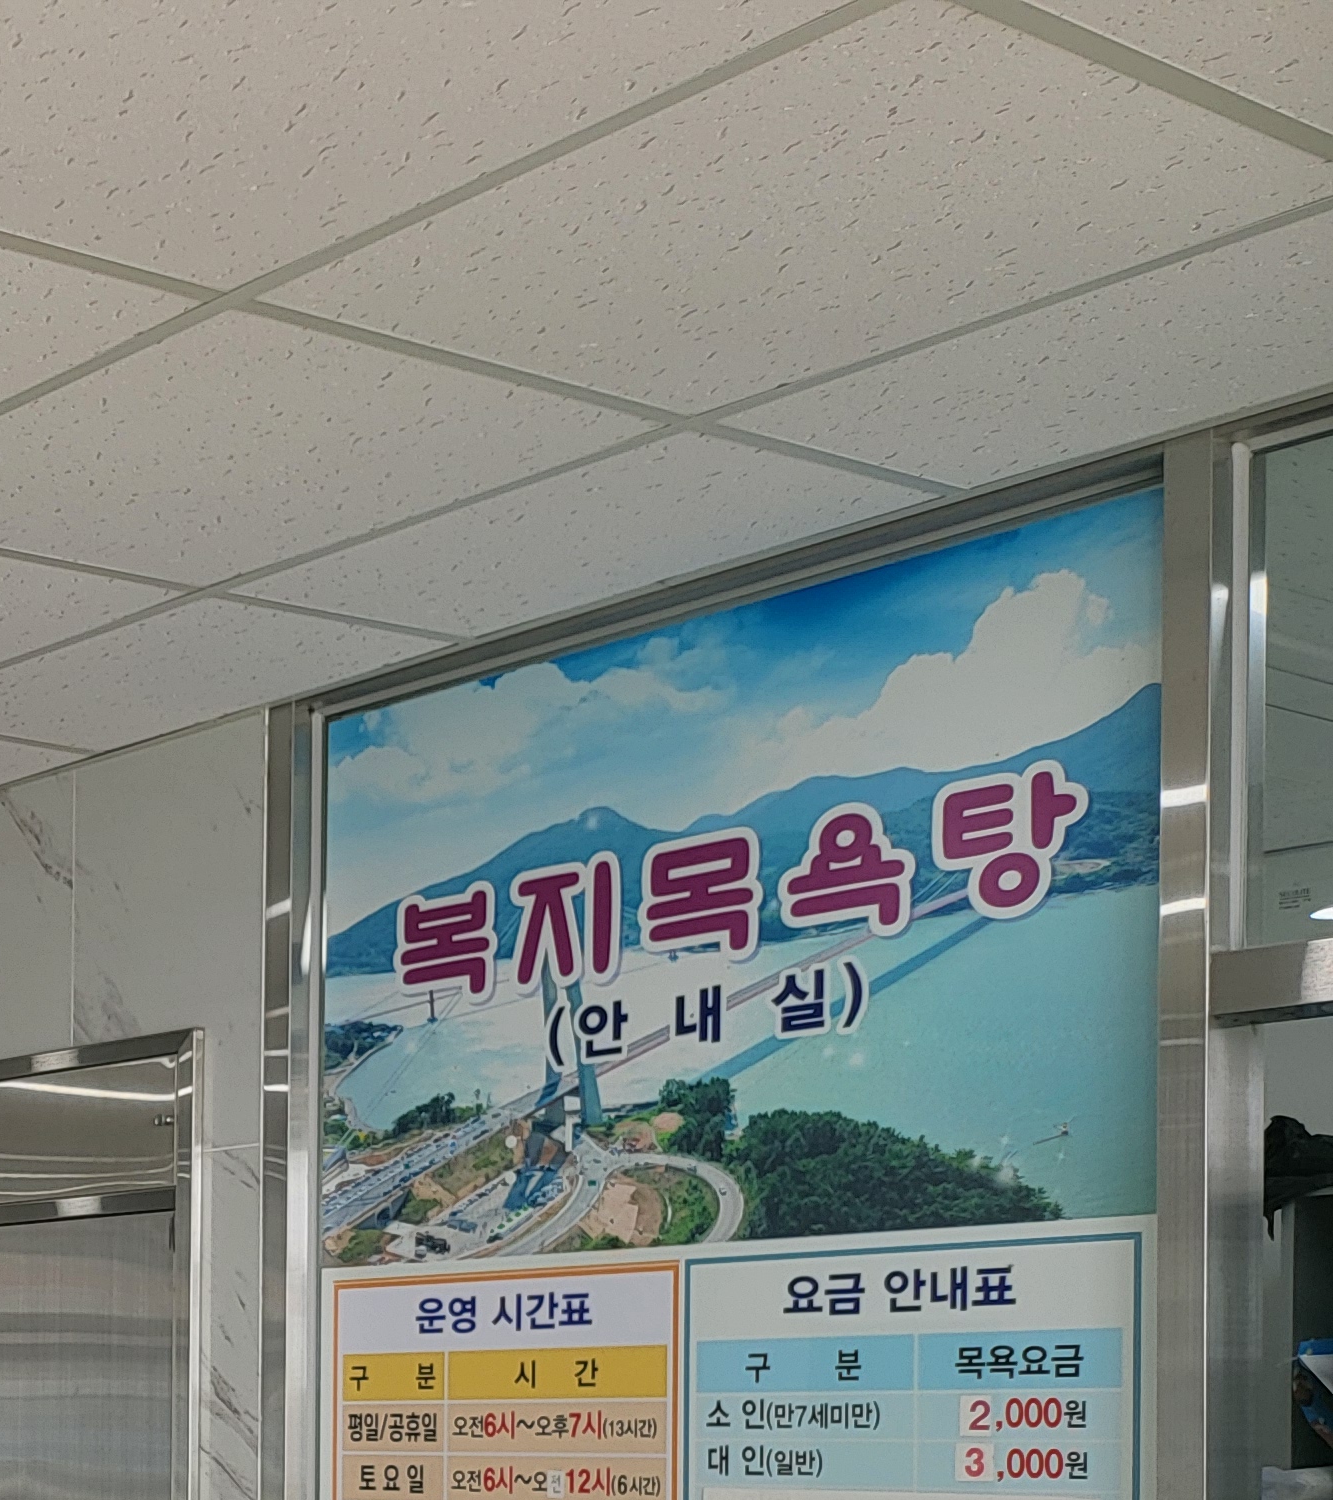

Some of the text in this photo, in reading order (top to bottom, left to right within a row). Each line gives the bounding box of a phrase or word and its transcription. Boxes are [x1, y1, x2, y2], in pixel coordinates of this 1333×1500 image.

[397, 763, 1086, 1000] 복지목욕탕
[783, 1264, 1017, 1316] 요금 안내표
[414, 1291, 593, 1334] 운영 시간표
[953, 1344, 1085, 1380] 목욕요금
[347, 1411, 438, 1443] 평일/공휴일
[967, 1397, 1088, 1433] 2,000원
[964, 1447, 1089, 1483] 3,000원
